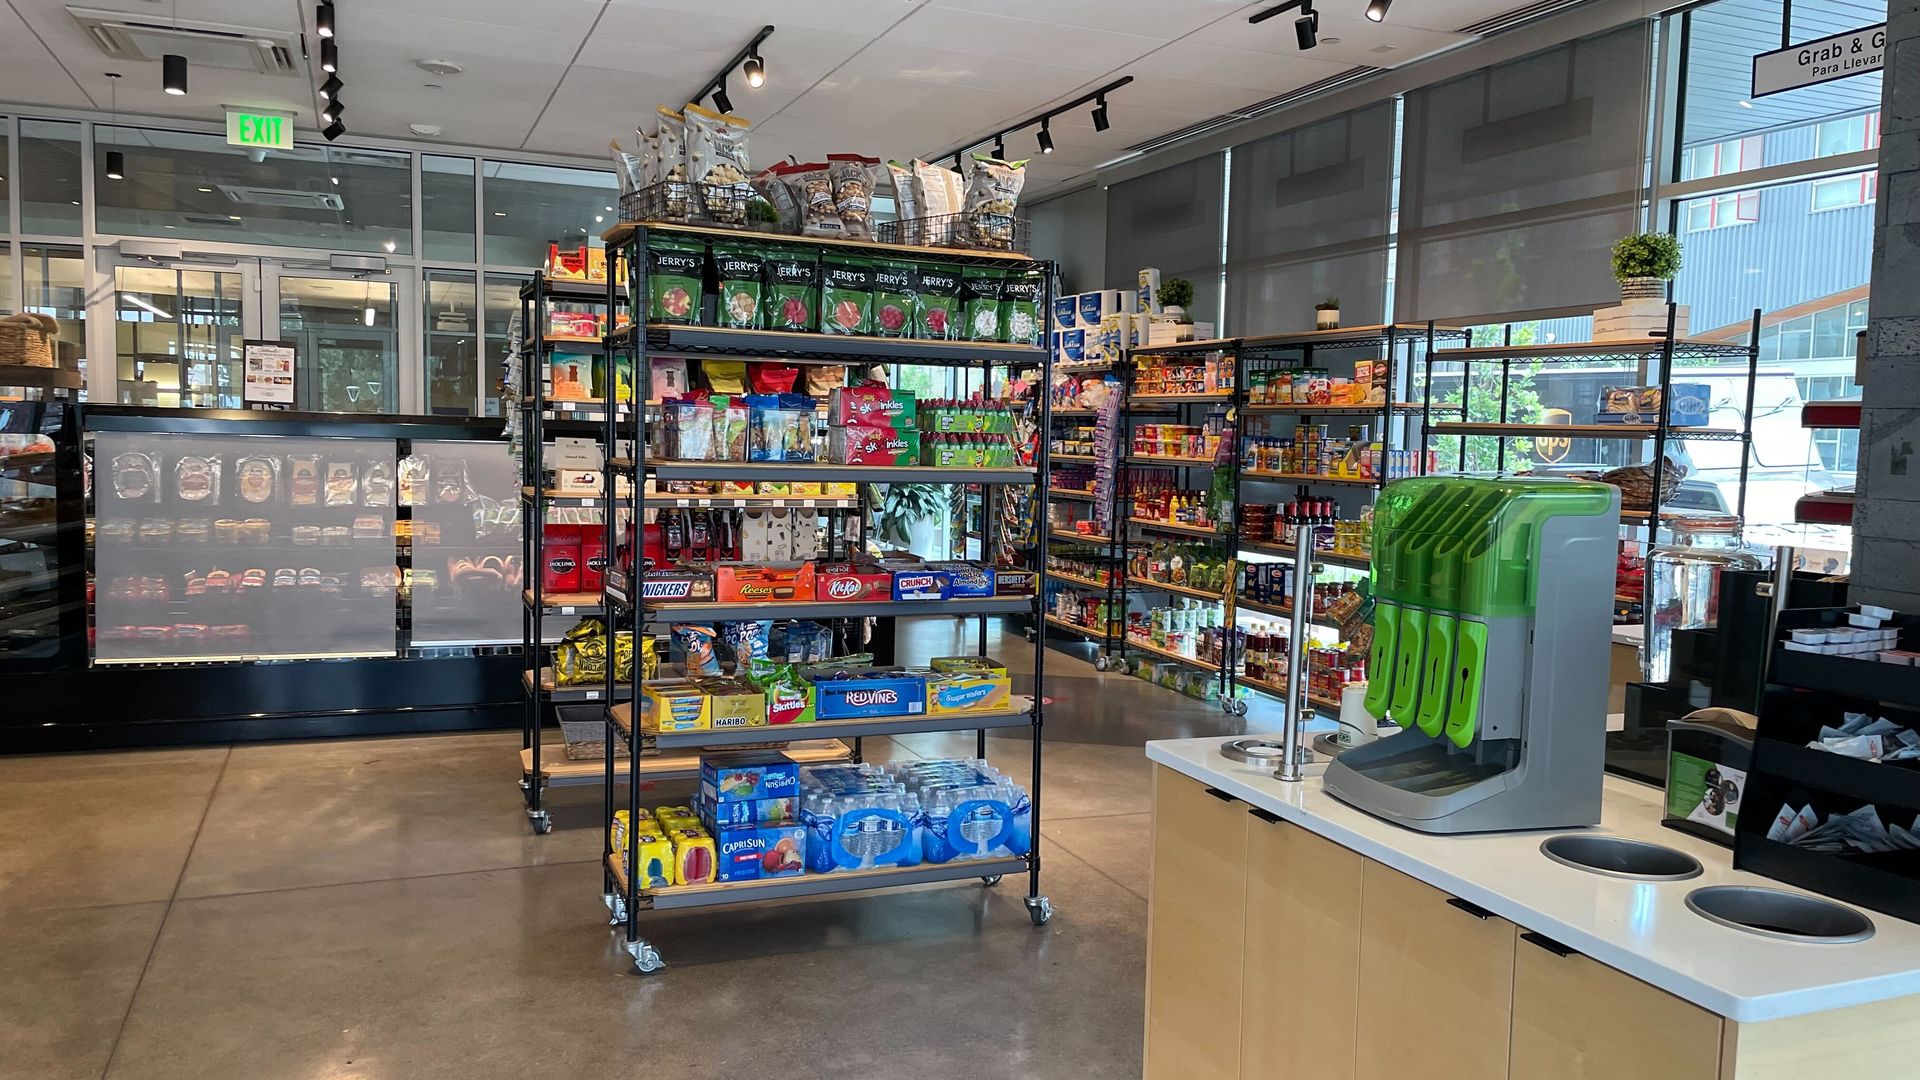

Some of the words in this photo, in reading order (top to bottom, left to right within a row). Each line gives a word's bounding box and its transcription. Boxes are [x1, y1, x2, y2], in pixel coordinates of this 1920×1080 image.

[1798, 43, 1842, 66] Grab
[1851, 38, 1863, 54] &
[1812, 64, 1839, 77] Para
[1844, 54, 1882, 70] Llevar
[239, 114, 283, 145] EXIT
[657, 256, 695, 268] JERRY'S
[724, 261, 758, 272] JERRY'S
[776, 265, 811, 277] JERRY'S
[832, 270, 866, 282] JERRY'S
[875, 273, 908, 286] JERRY'S
[921, 275, 953, 288] JERRY'S
[971, 282, 1000, 291] JERRY'S
[1006, 284, 1037, 294] JERRY'S
[860, 400, 903, 414] skinkles
[865, 438, 909, 453] skinkles
[901, 577, 932, 588] CRUNCH
[953, 578, 977, 587] Almond
[977, 576, 988, 587] Joy
[998, 575, 1026, 584] HERSHEY'S
[643, 582, 689, 597] NICKERS
[946, 692, 965, 702] Sugar
[966, 688, 987, 700] wafers
[773, 701, 805, 712] Skittles
[715, 717, 746, 727] HARIBO
